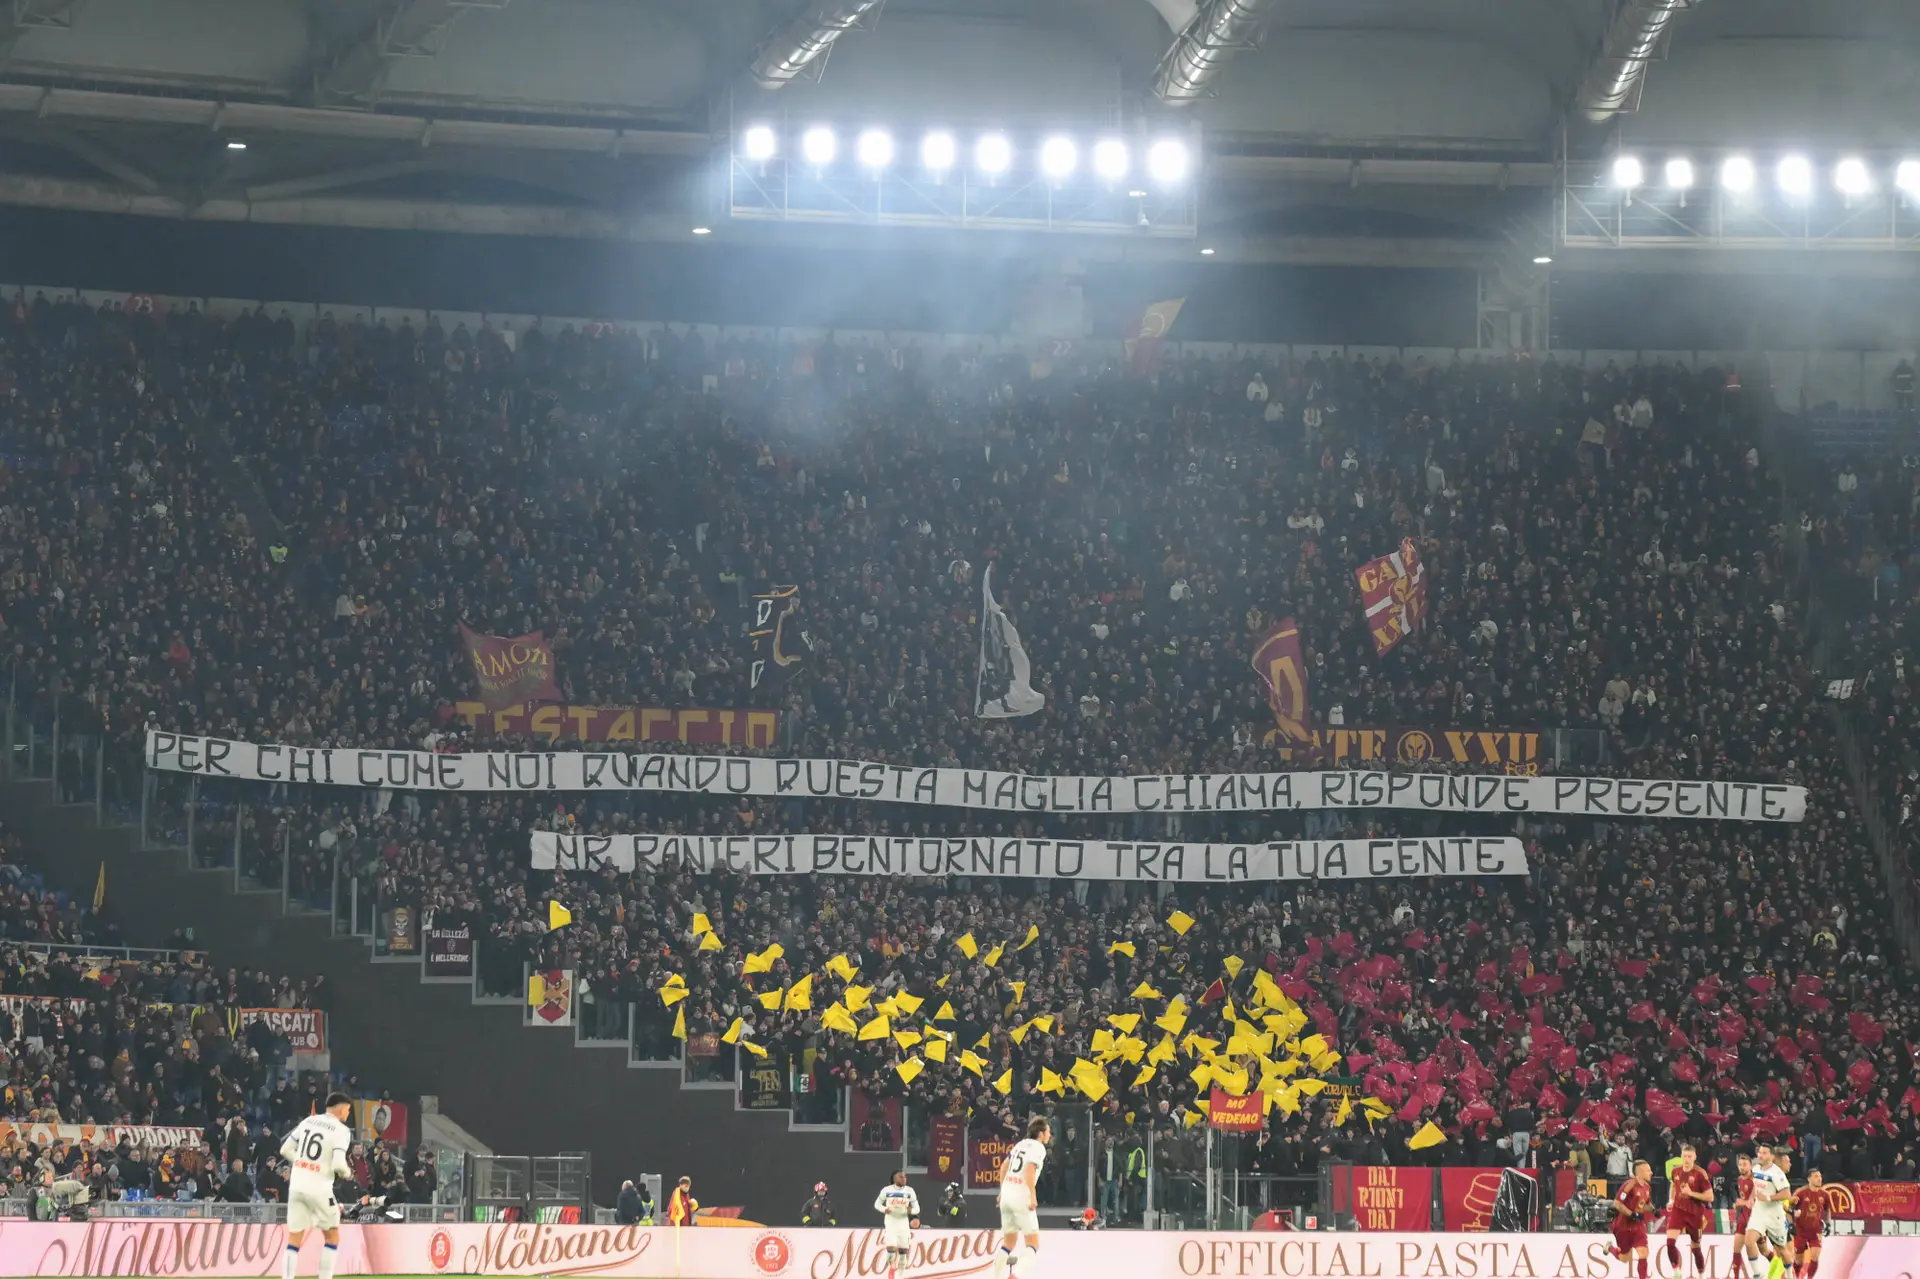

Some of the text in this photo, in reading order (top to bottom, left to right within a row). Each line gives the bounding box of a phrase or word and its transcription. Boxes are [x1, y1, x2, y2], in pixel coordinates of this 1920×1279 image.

[134, 296, 153, 313] 23
[456, 701, 775, 746] TESTACCIO
[1443, 730, 1540, 764] XXII
[152, 731, 1788, 820] PER CHI COME NOI QUANDO QUESTA MAGLIA CHIAMA, RISPONDE PRESENTE
[555, 834, 1504, 880] MR RANIERI BENTORNATO TRA LA TUA GENTE
[1212, 1111, 1259, 1125] VEDEMO
[300, 1128, 324, 1161] 16
[975, 1170, 1001, 1183] MOR
[463, 1222, 651, 1274] Molisana
[513, 1224, 528, 1240] la
[810, 1228, 1004, 1279] Moisana
[1178, 1240, 1382, 1277] OFFICIAL
[1396, 1241, 1539, 1278] PASTA
[1552, 1242, 1610, 1279] AS
